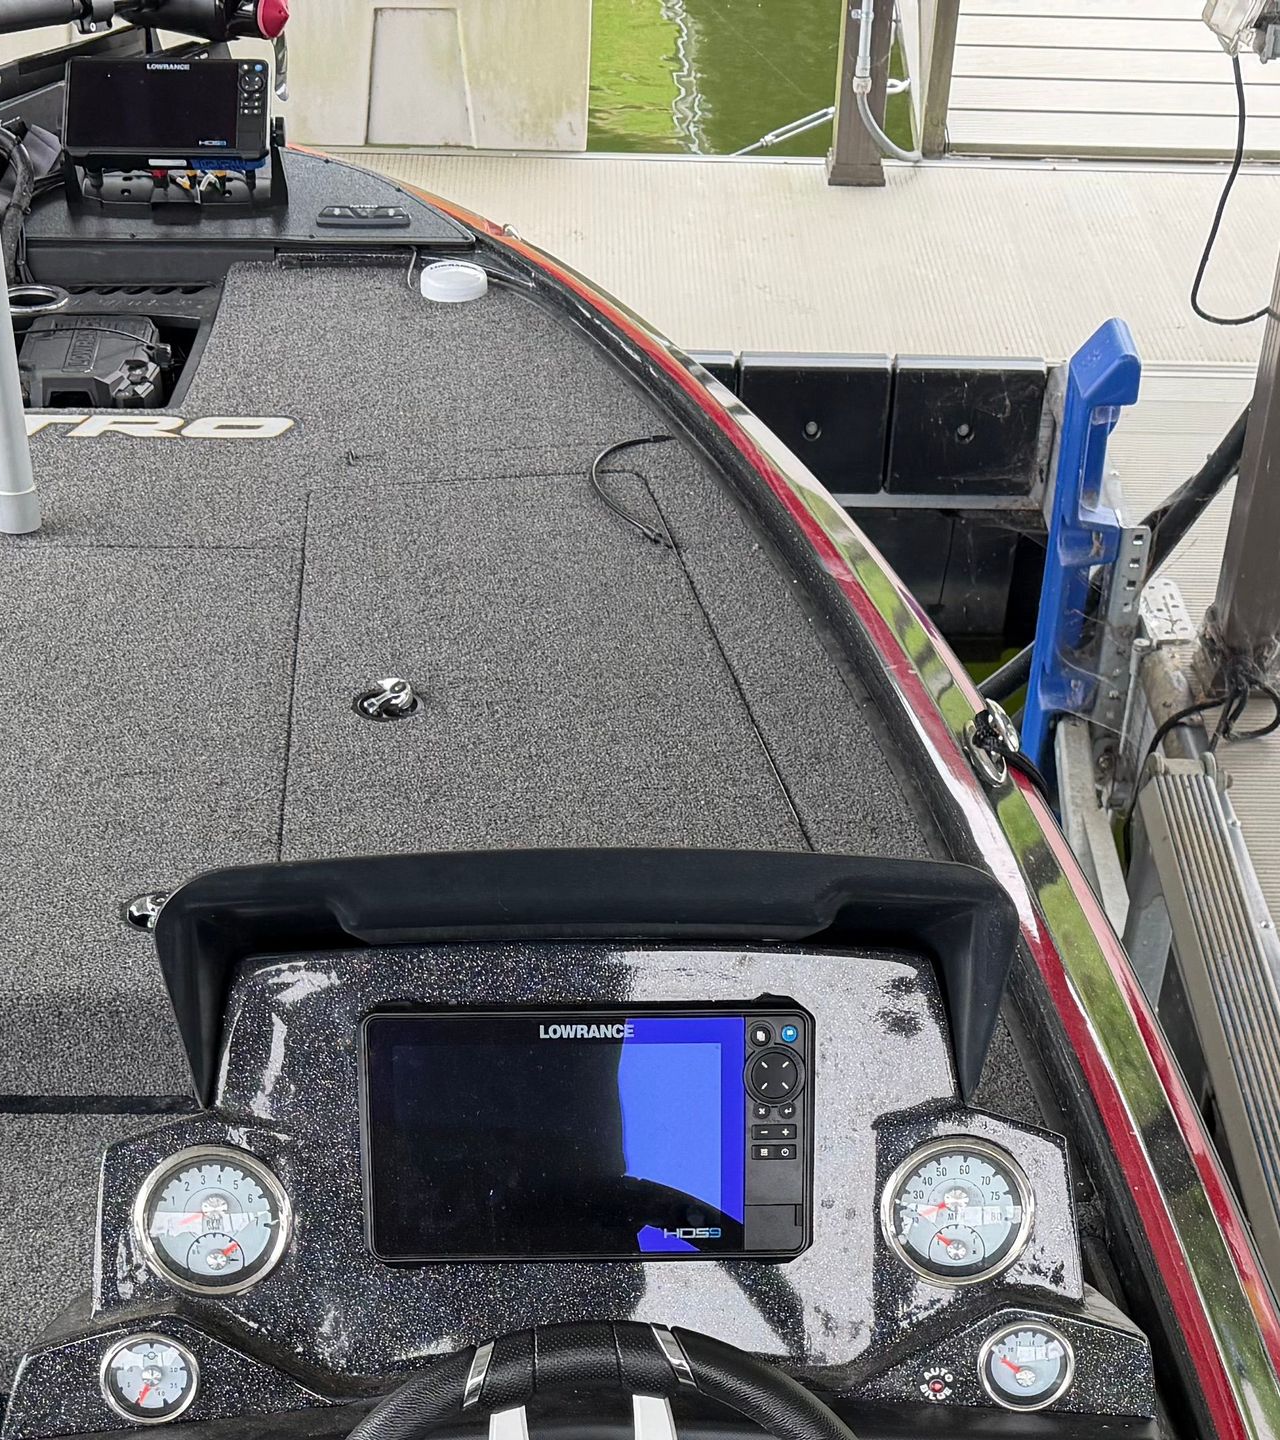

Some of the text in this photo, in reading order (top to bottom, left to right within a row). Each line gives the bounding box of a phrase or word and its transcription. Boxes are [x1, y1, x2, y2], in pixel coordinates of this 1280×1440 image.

[146, 63, 191, 71] LOWRANCE
[539, 1024, 635, 1039] LOWRANCE
[936, 1167, 947, 1177] 50
[959, 1164, 970, 1175] 60
[200, 1175, 206, 1185] 3
[216, 1174, 222, 1185] 4
[233, 1179, 239, 1189] 5
[922, 1176, 933, 1186] 40
[980, 1175, 991, 1186] 70
[184, 1182, 190, 1192] 2
[247, 1193, 253, 1203] 6
[913, 1190, 924, 1200] 30
[990, 1191, 1000, 1201] 75
[990, 1212, 1002, 1222] 80
[663, 1227, 722, 1239] HDS9
[923, 1367, 953, 1383] AUTO
[920, 1384, 953, 1400] BILGE
